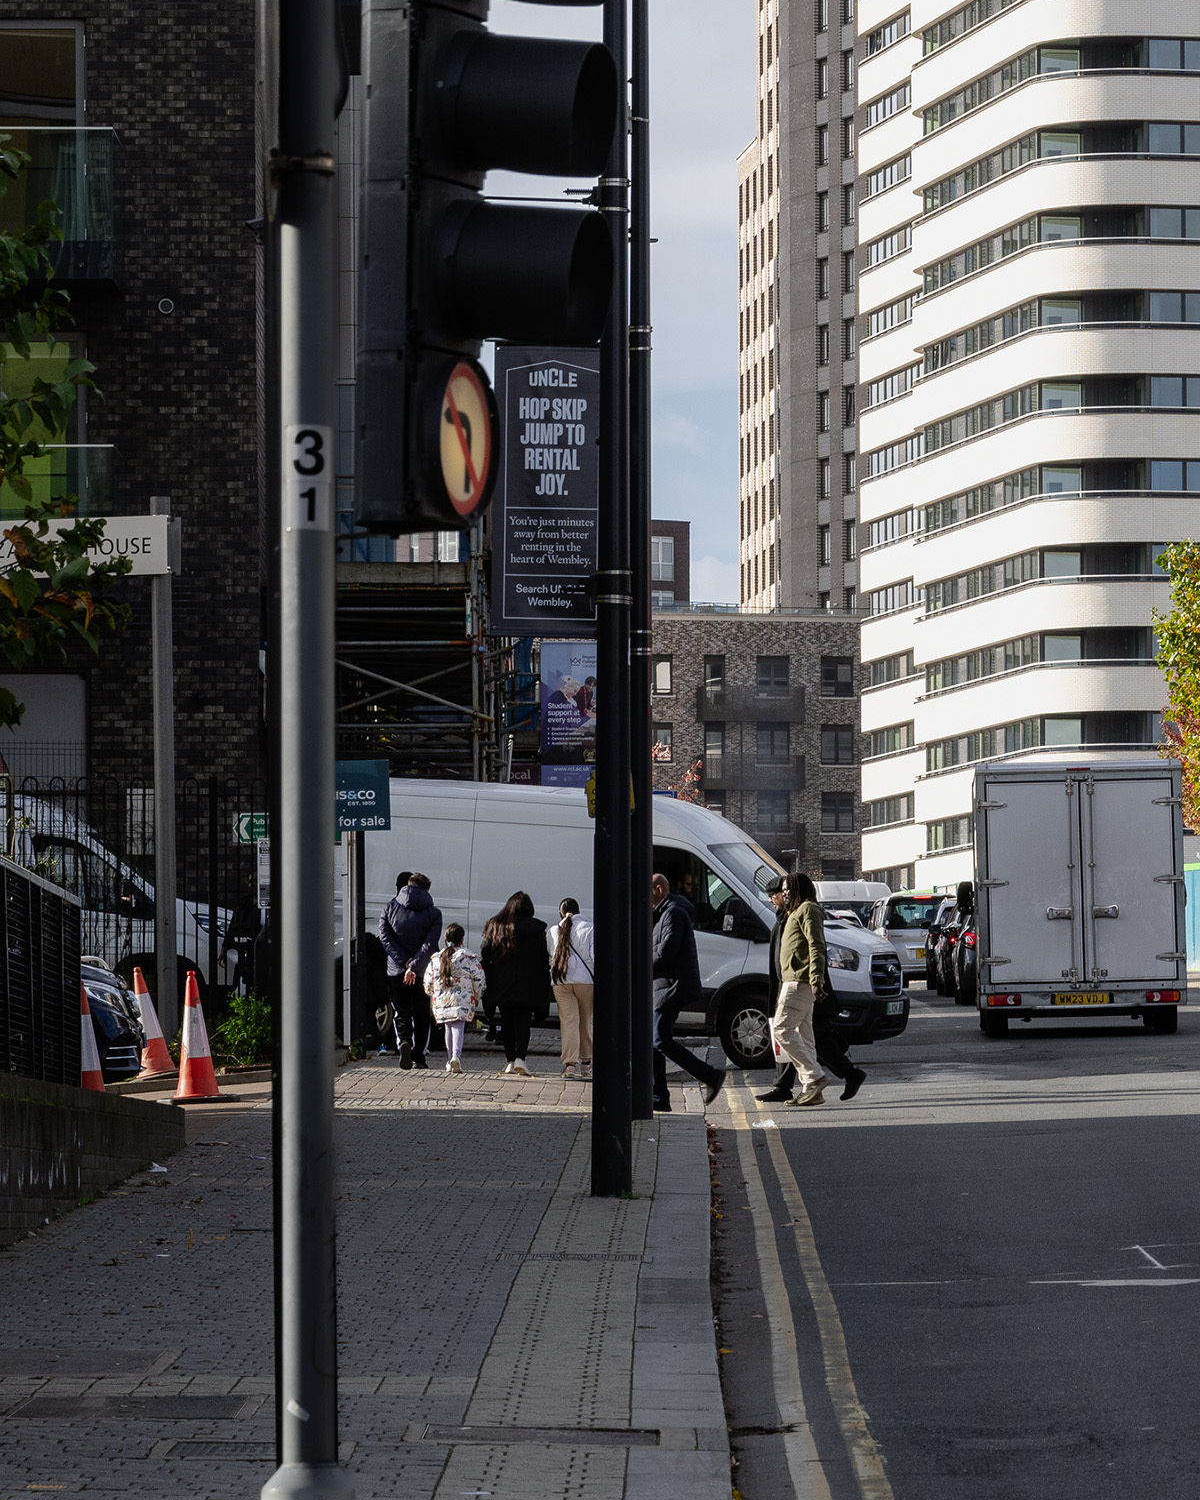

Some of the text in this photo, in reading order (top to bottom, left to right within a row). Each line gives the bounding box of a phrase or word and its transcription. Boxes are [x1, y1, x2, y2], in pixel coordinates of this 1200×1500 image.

[529, 368, 577, 387] UNCLE
[519, 397, 588, 420] HOP SKIP
[520, 423, 586, 446] JUMP TO
[294, 430, 324, 476] 3
[524, 448, 580, 470] RENTAL
[536, 474, 568, 496] JOY.
[300, 486, 316, 522] 1
[509, 516, 594, 529] You're just minutes
[514, 529, 590, 541] away from better
[521, 542, 582, 554] renting in the
[510, 553, 592, 567] heart of Wembley.
[516, 584, 548, 594] Search
[528, 597, 572, 608] Wembley.
[334, 790, 376, 800] IS&CO
[339, 815, 386, 826] for sale
